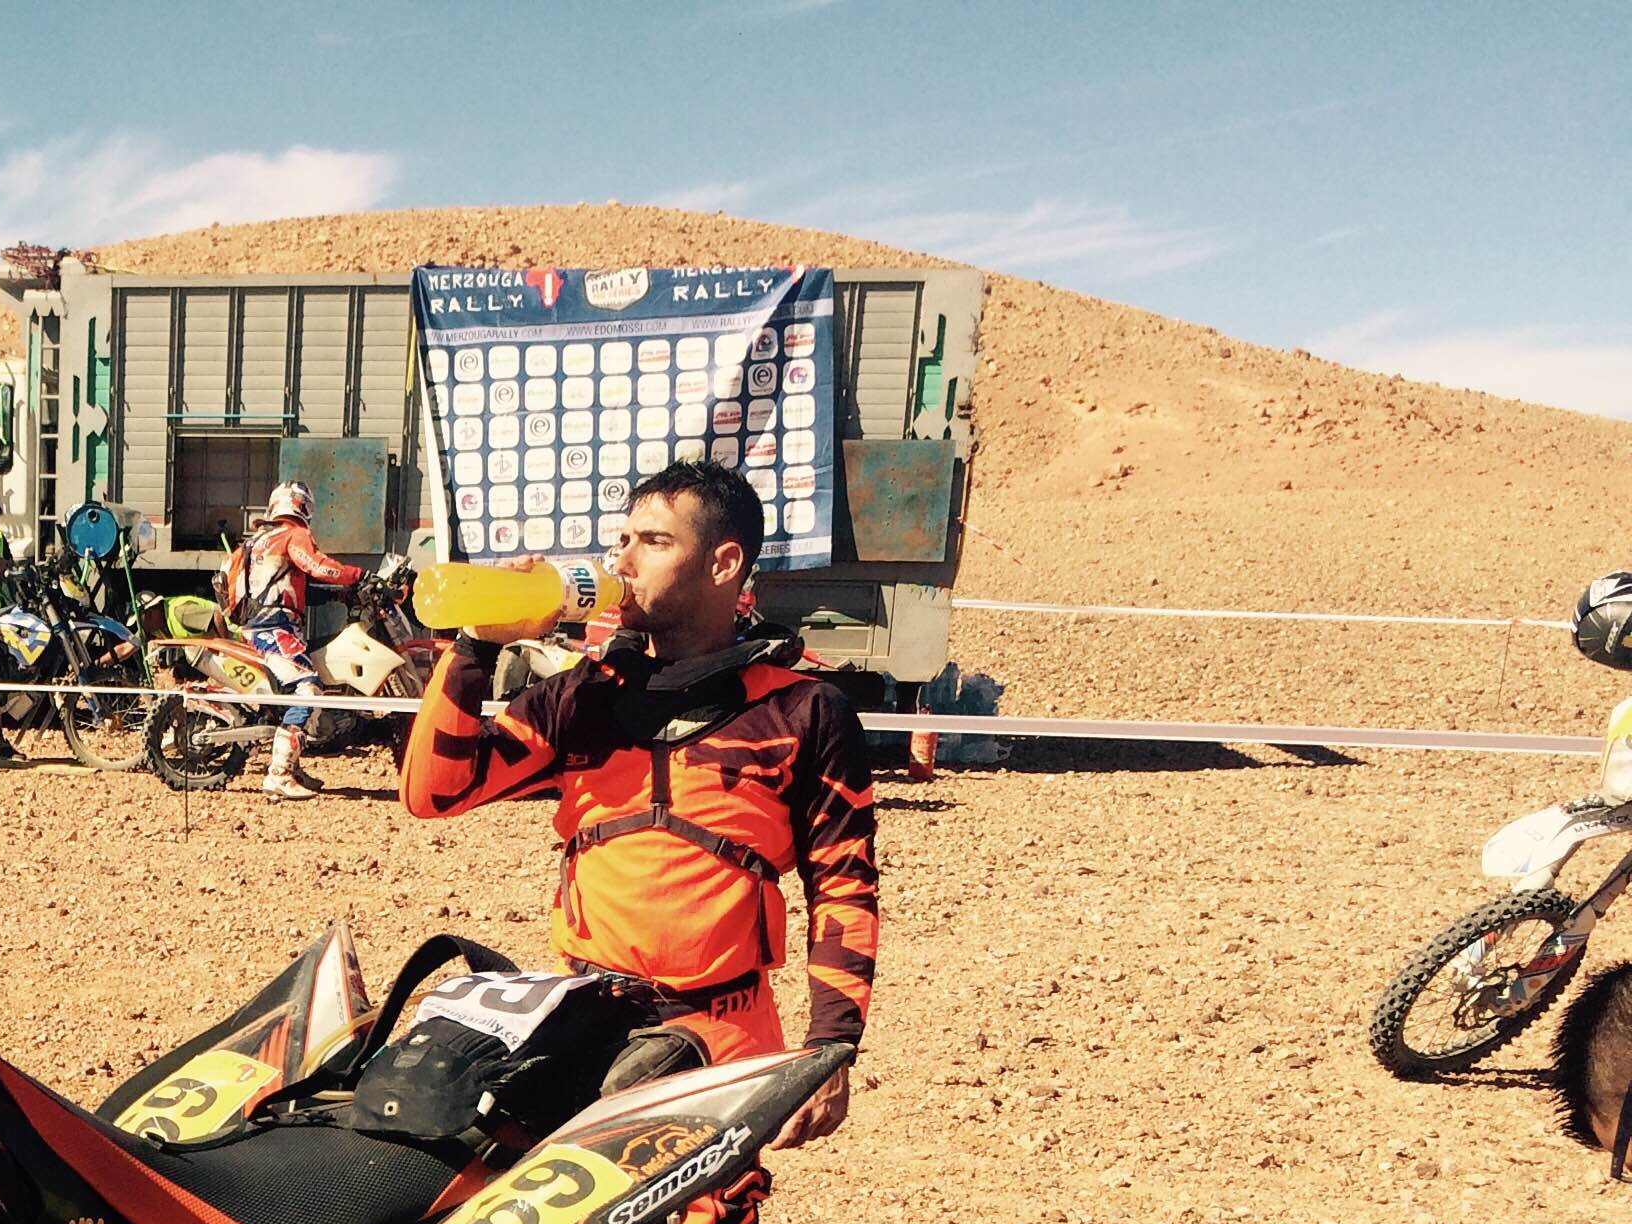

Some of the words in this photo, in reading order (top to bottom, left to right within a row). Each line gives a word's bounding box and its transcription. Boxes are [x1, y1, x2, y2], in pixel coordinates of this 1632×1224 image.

[428, 271, 524, 291] MERZOUGA
[672, 278, 774, 302] RALLY
[430, 294, 524, 315] RALLY
[229, 664, 256, 688] 49
